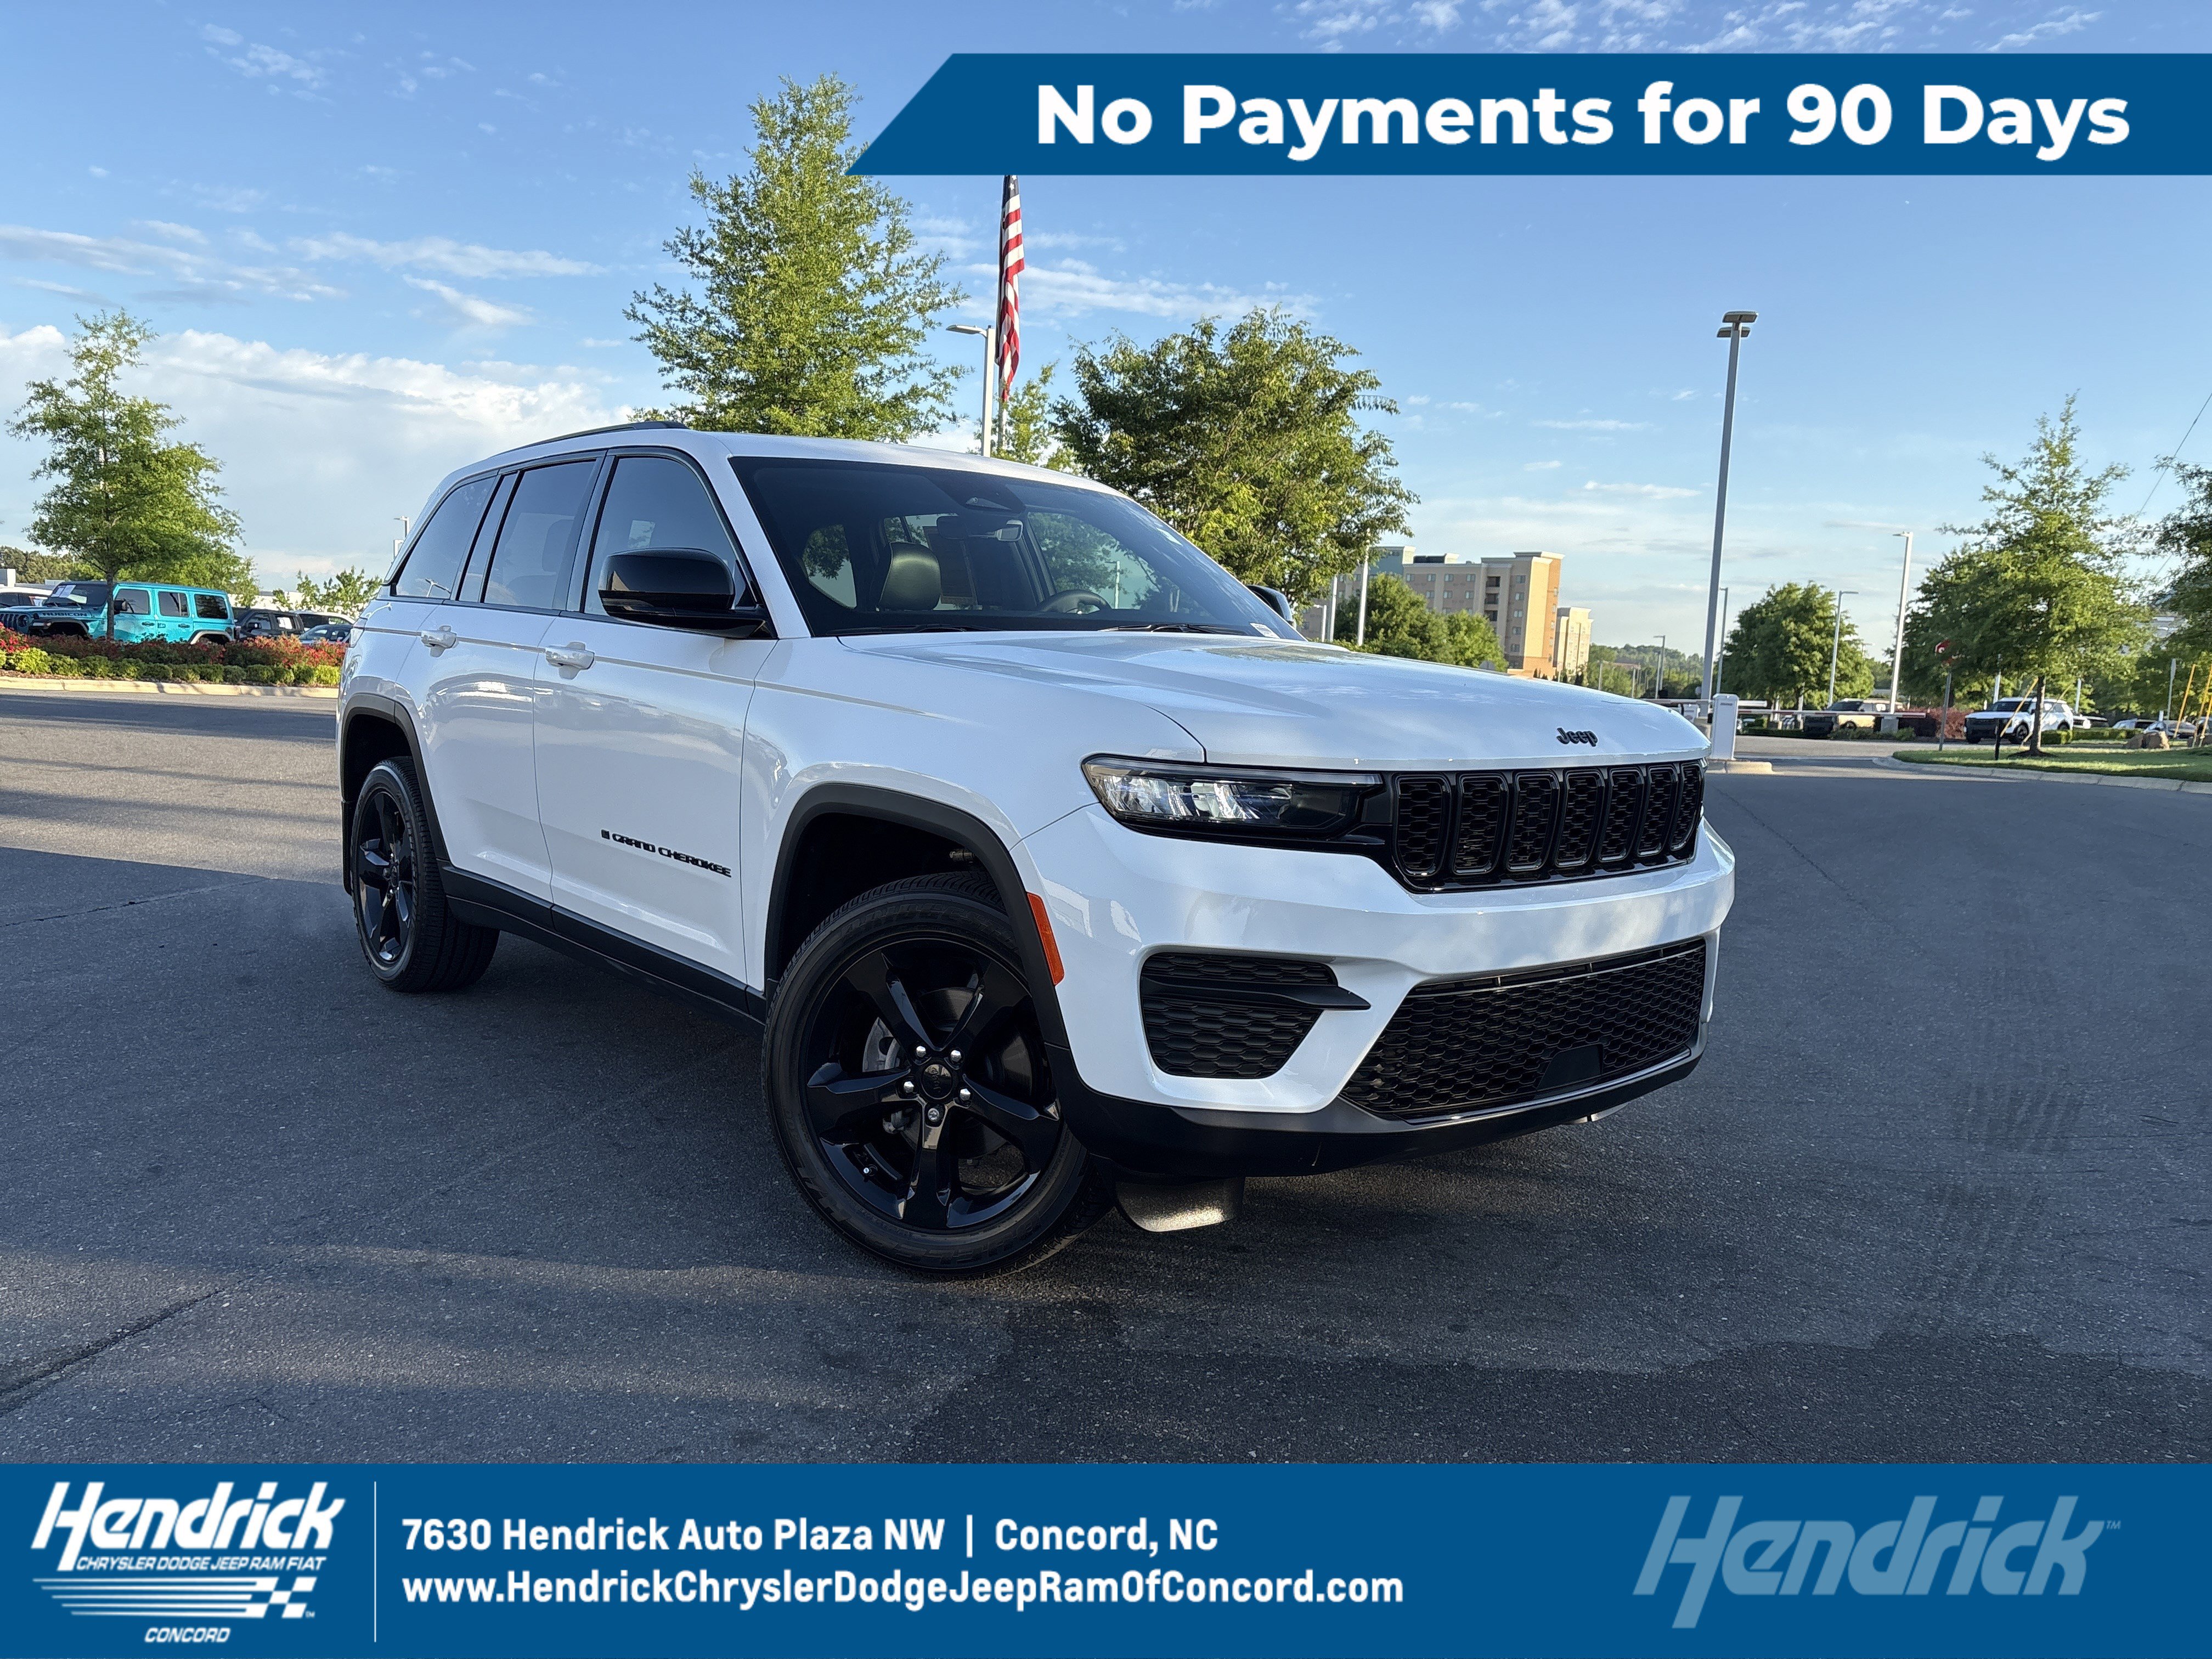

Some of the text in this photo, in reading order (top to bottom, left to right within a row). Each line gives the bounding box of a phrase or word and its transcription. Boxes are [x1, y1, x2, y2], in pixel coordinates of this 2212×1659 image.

[1556, 727, 1598, 747] Jeep
[612, 833, 732, 878] GRAND CHEROKEE
